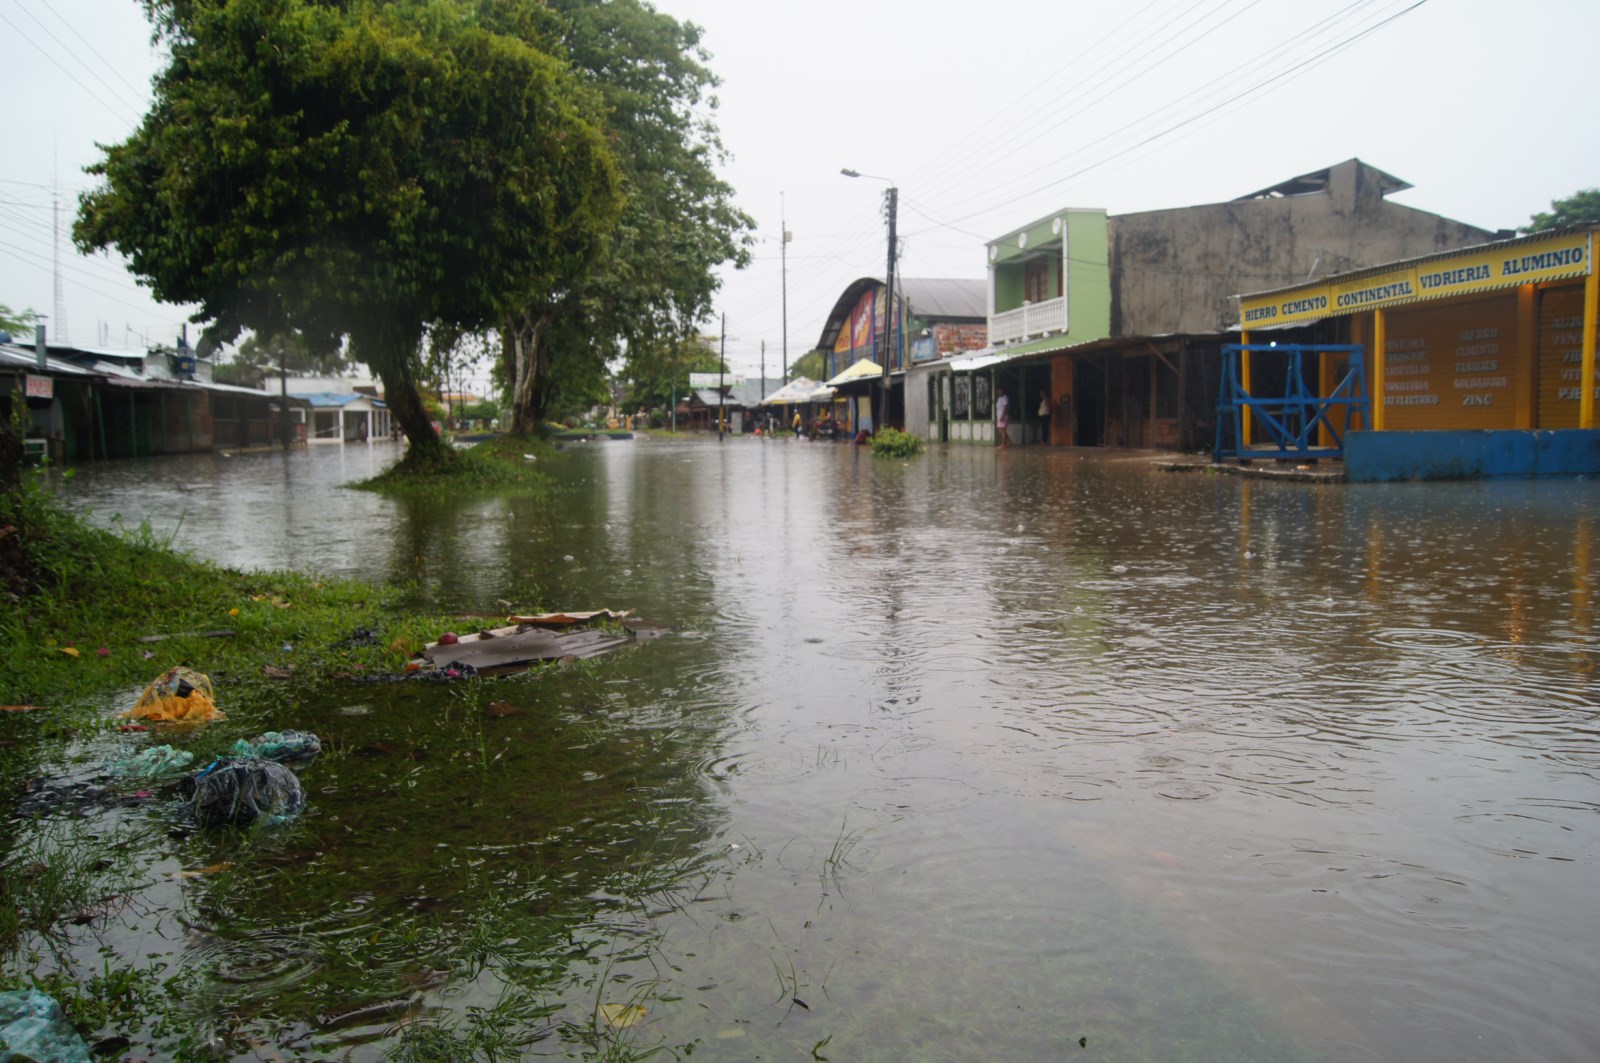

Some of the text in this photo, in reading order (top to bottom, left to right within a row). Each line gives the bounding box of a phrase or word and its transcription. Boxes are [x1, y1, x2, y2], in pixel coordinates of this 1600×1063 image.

[1420, 248, 1583, 289] VIDRIERIA ALUMINIO
[1337, 281, 1412, 307] CONTINENTAL
[1246, 296, 1327, 322] HIERRO CEMENTO
[1463, 394, 1494, 406] ZINC
